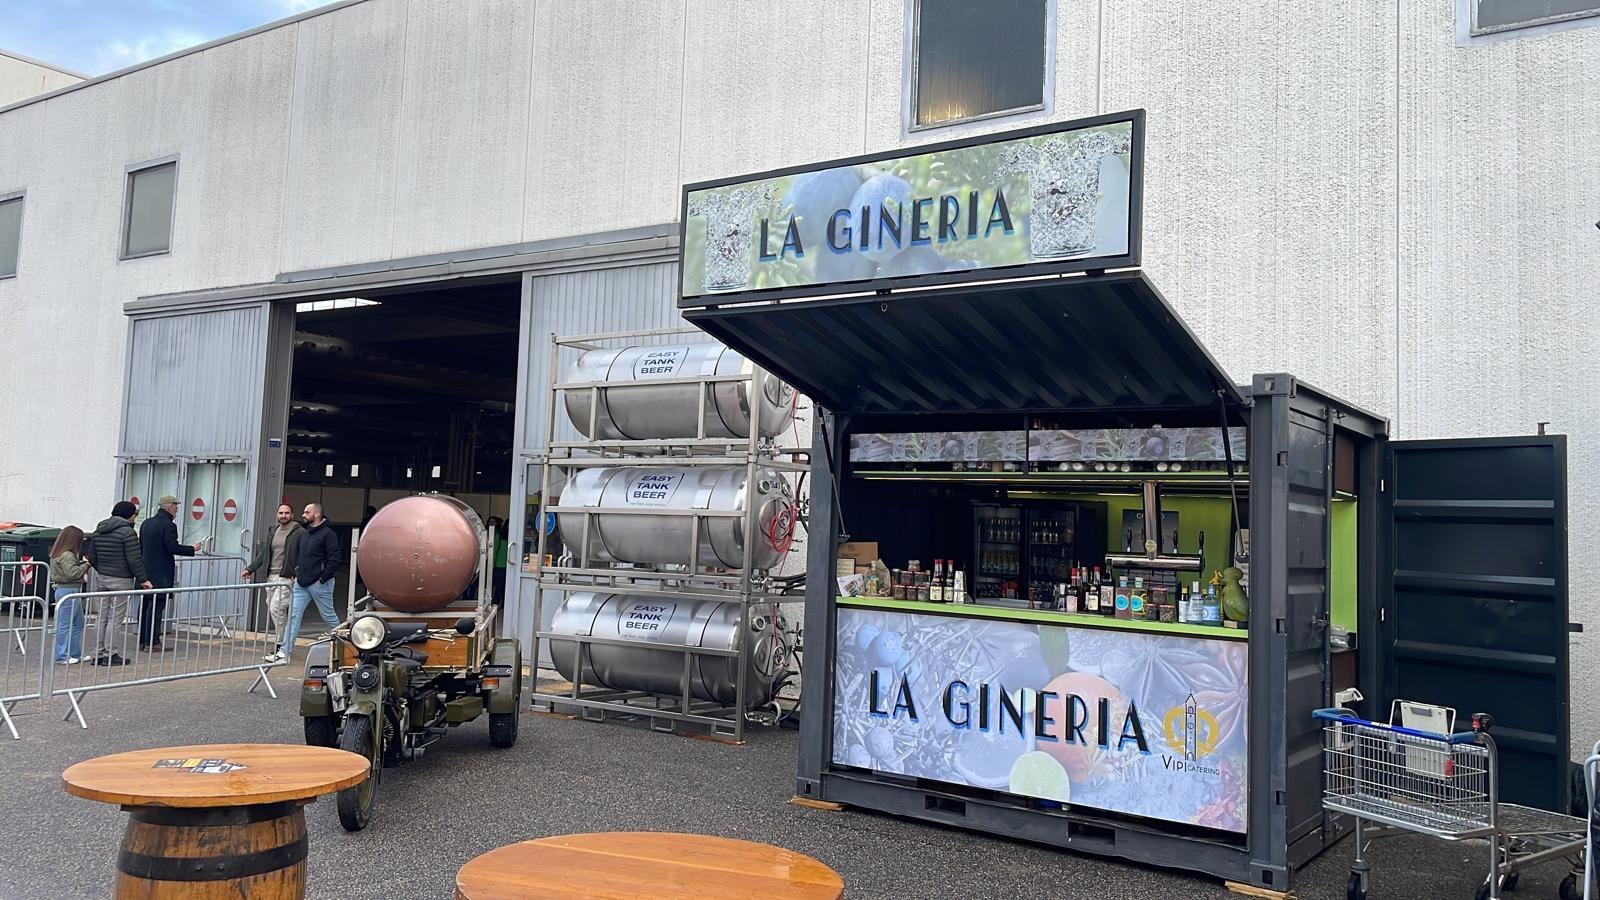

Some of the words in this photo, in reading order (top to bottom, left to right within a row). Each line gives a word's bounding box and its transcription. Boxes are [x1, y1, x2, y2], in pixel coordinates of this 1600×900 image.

[759, 214, 806, 262] LA
[826, 187, 1016, 256] GINERIA
[644, 358, 676, 366] TANK
[641, 366, 674, 374] BEER
[637, 482, 670, 490] TANK
[633, 491, 667, 499] BEER
[629, 612, 662, 621] TANK
[626, 621, 659, 631] BEER
[869, 670, 918, 720] LA
[942, 680, 1151, 754] GINERIA
[1187, 765, 1221, 776] CATERING
